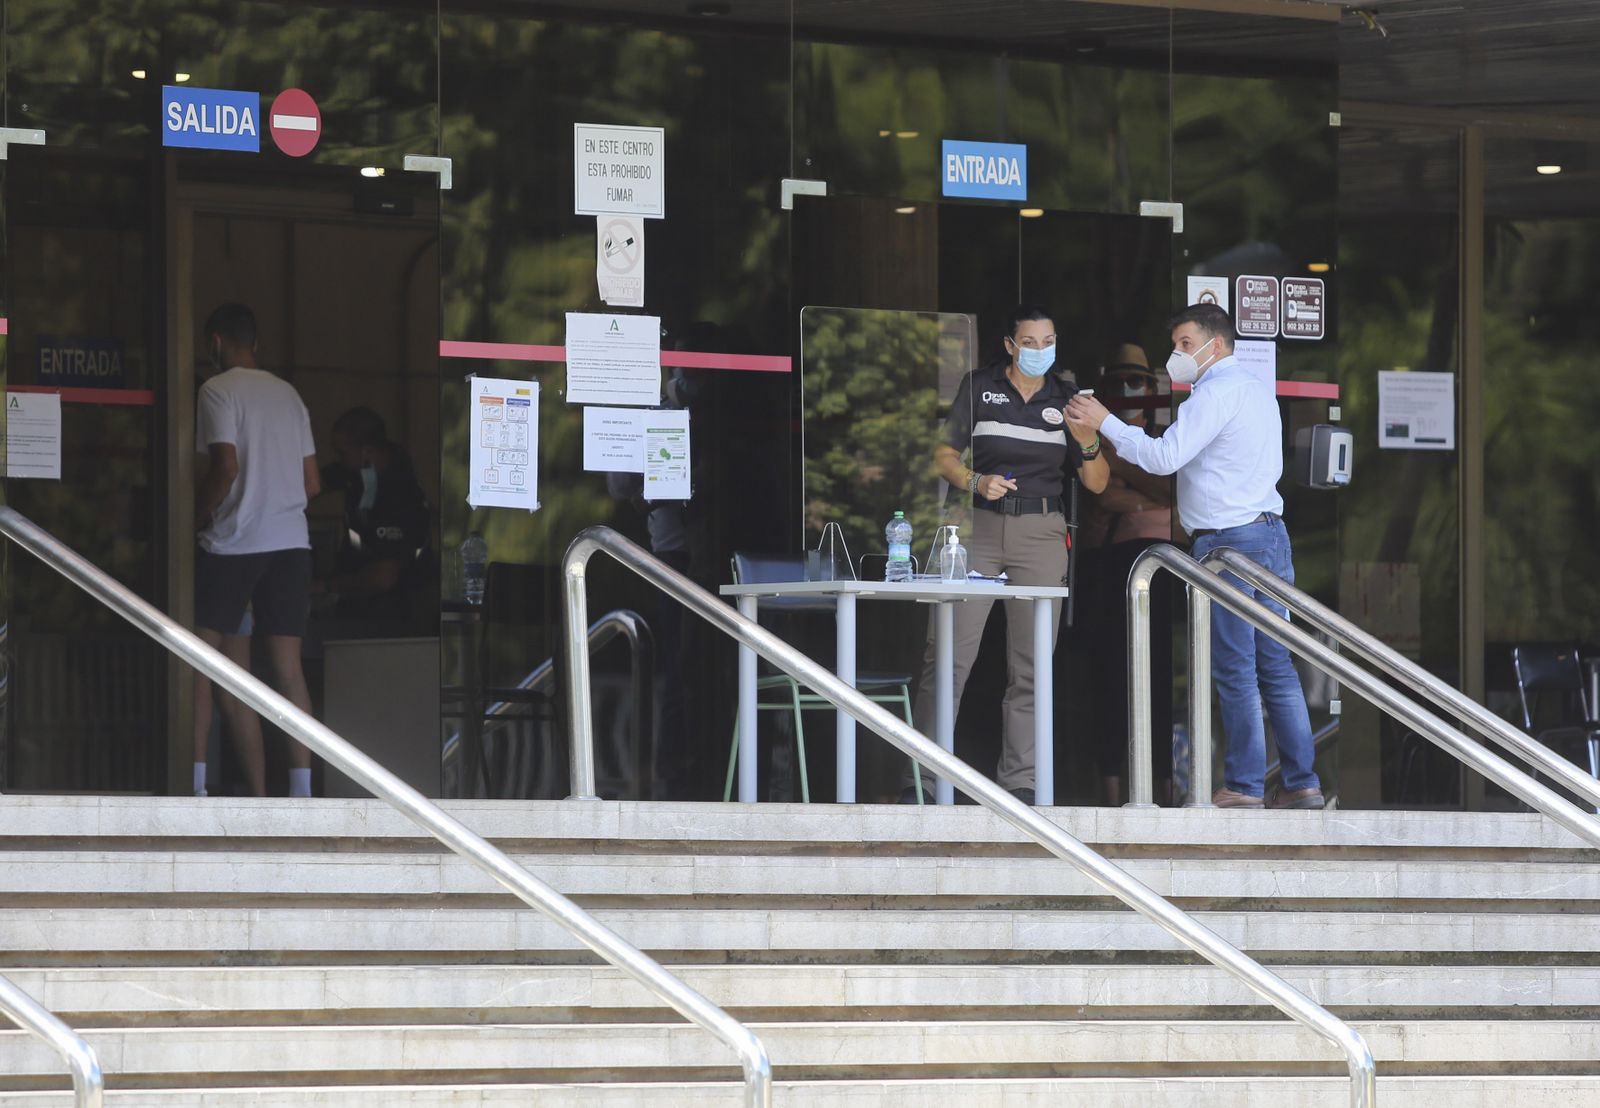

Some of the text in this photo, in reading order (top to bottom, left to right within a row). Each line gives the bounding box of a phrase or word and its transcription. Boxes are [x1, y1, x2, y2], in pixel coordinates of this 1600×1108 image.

[167, 101, 257, 136] SALIDA
[585, 139, 654, 156] EN ESTE CENTRO
[588, 162, 652, 180] ESTA PROHIBIDO
[947, 154, 1022, 186] ENTRADA
[606, 187, 633, 202] FUMAR
[1287, 322, 1297, 330] 902
[1305, 323, 1312, 331] 22
[1313, 323, 1320, 331] 22
[41, 348, 121, 376] ENTRADA
